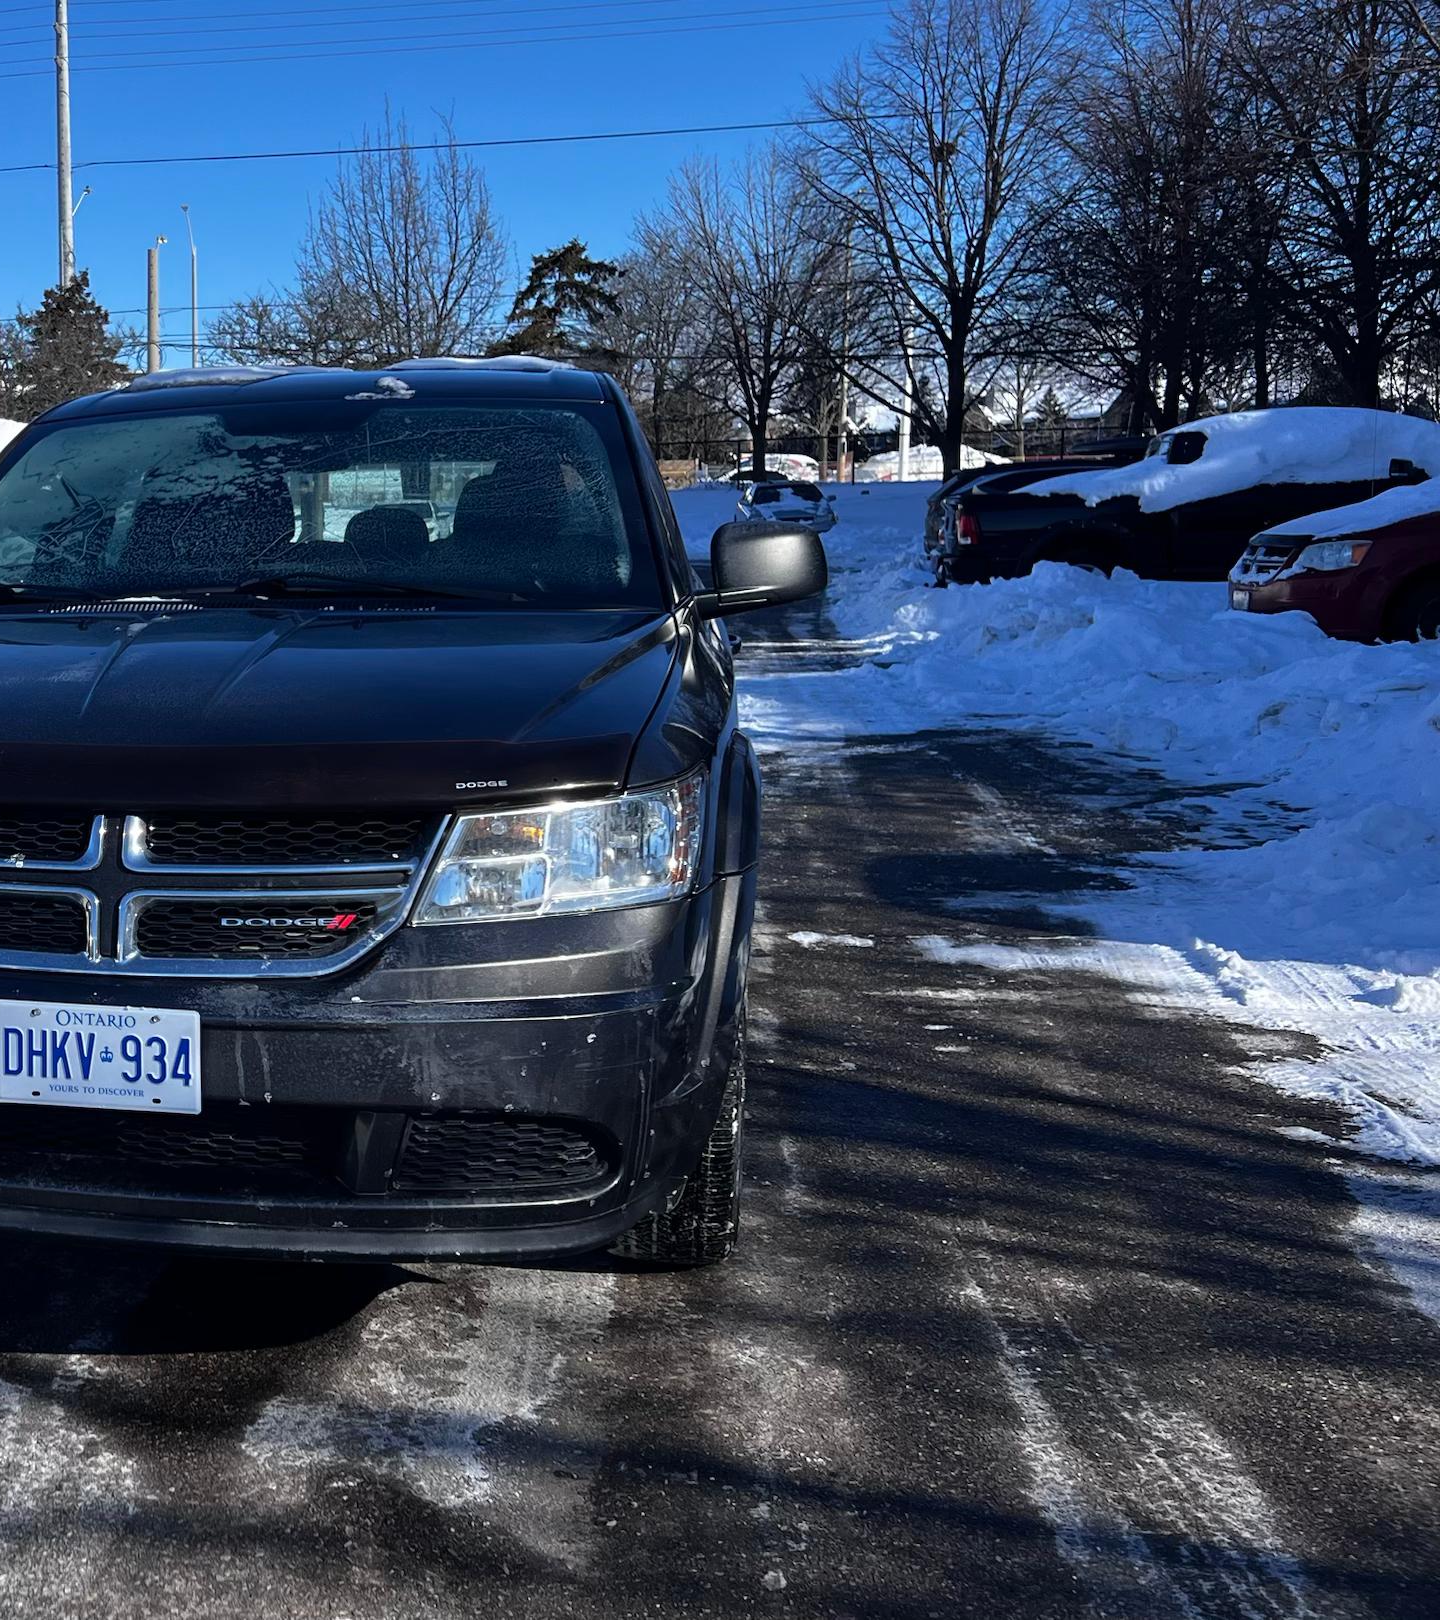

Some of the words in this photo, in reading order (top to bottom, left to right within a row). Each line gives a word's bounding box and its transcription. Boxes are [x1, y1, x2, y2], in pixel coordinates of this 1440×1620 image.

[455, 780, 509, 790] DODGE
[220, 917, 339, 927] DODGE
[55, 1009, 137, 1031] ONTARIO
[3, 1027, 96, 1081] DHKV
[120, 1034, 193, 1087] 934
[49, 1083, 79, 1095] YOURS
[83, 1085, 96, 1095] TO
[98, 1086, 145, 1098] DISCOVER
